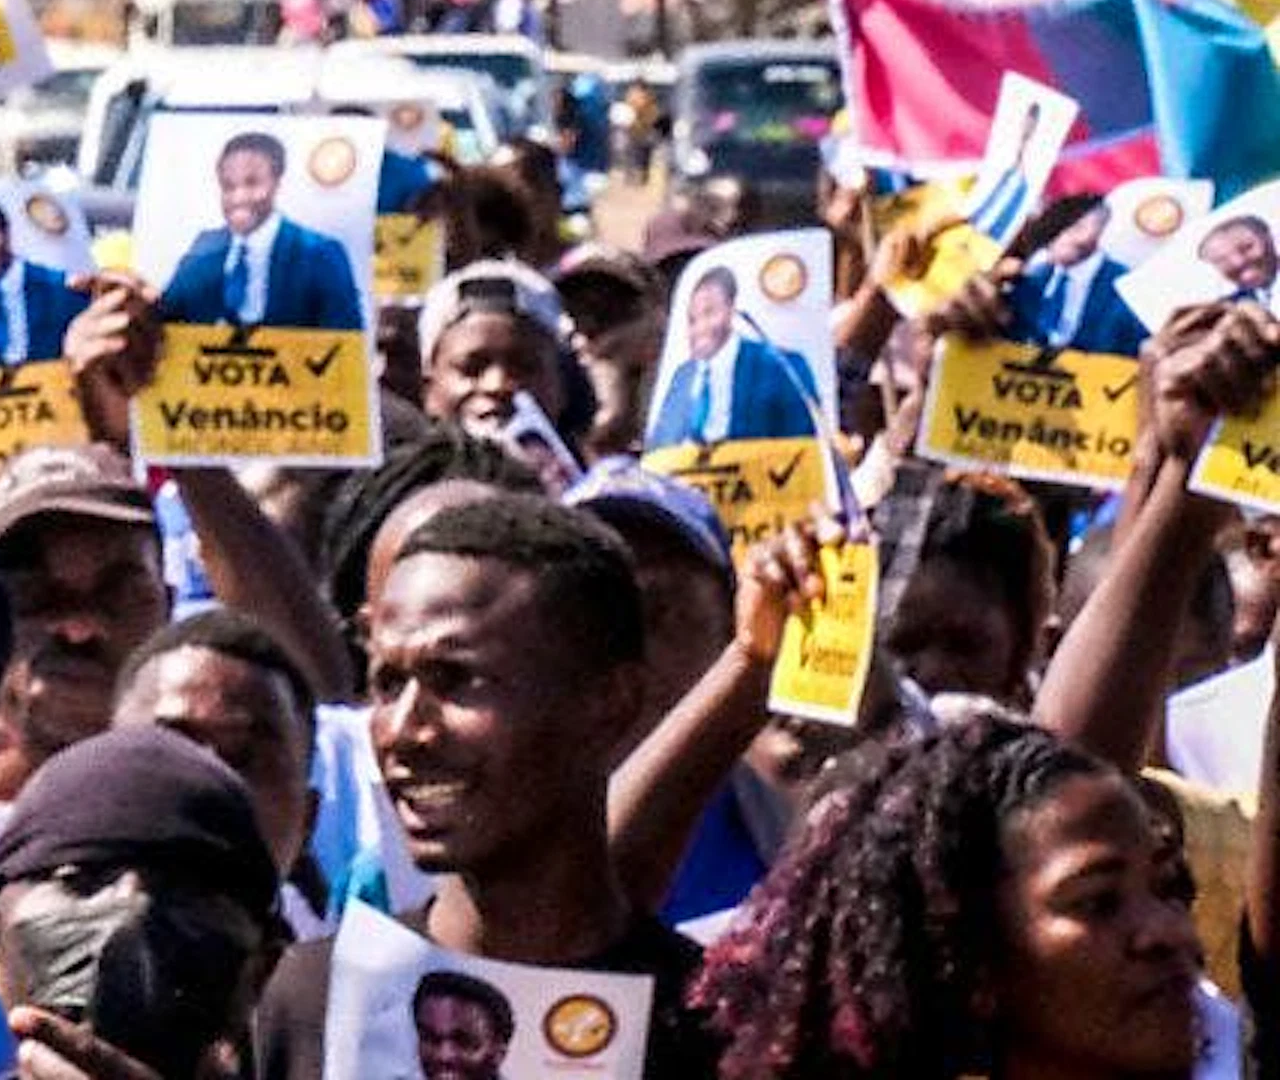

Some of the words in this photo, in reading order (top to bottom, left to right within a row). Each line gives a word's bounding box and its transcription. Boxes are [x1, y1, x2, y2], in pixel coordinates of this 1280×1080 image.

[194, 359, 291, 388] VOTA
[993, 374, 1083, 410] VOTA
[158, 399, 350, 434] Venâncio
[952, 404, 1132, 458] Venâncio
